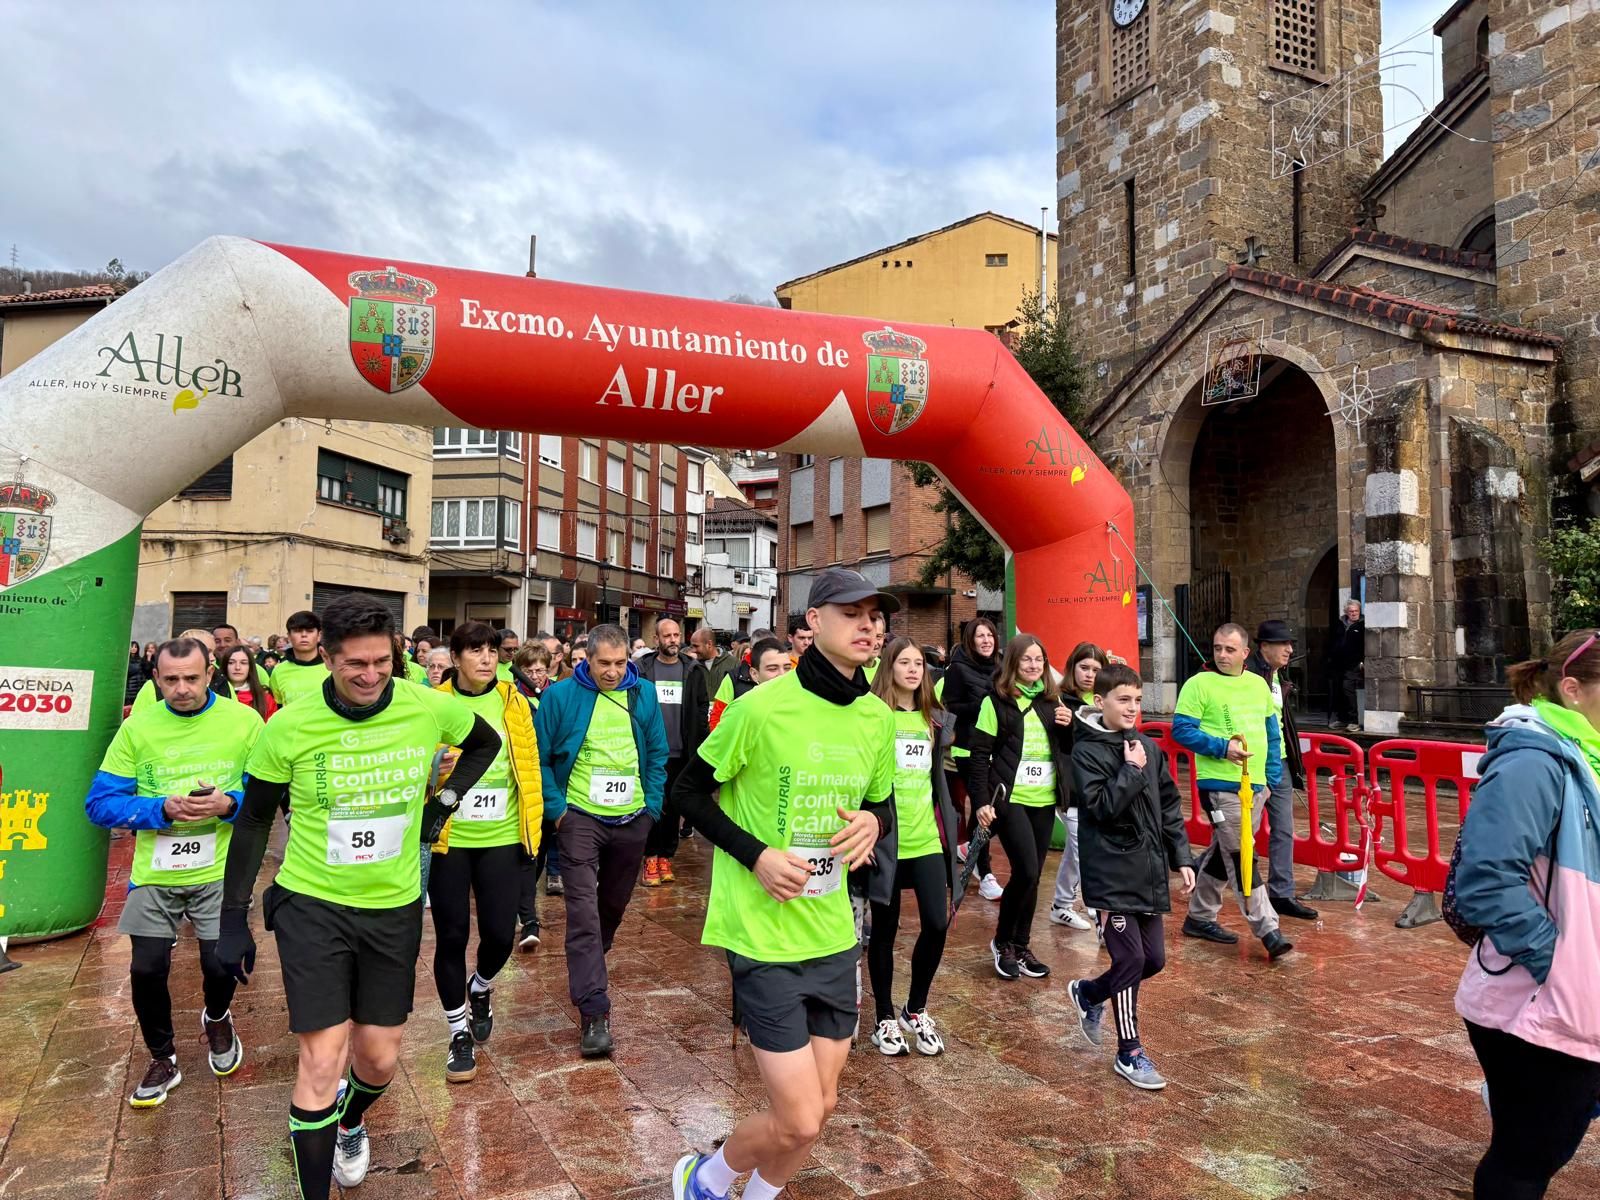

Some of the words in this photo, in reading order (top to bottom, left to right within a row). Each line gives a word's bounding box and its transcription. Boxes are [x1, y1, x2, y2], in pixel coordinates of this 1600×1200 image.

[460, 298, 574, 340] Excmo.
[583, 313, 808, 364] Ayuntamiento
[816, 341, 849, 368] de
[28, 379, 68, 390] ALLER,
[73, 380, 97, 391] HOY
[99, 381, 109, 392] Y
[112, 384, 168, 401] SIEMPRE
[596, 363, 724, 414] Aller
[1010, 468, 1026, 476] HOY
[1035, 469, 1069, 477] SIEMPRE
[51, 596, 67, 606] de
[0, 679, 74, 692] AGENDA
[662, 688, 674, 696] 114
[0, 693, 73, 713] 2030
[332, 754, 355, 769] En
[361, 745, 426, 765] marcha
[905, 744, 925, 757] 247
[157, 765, 176, 777] En
[180, 759, 235, 774] marcha
[332, 768, 405, 788] contra
[408, 761, 425, 779] el
[1026, 766, 1042, 777] 163
[217, 771, 231, 784] el
[314, 752, 329, 810] ASTURIAS
[796, 770, 818, 786] En
[605, 781, 627, 793] 210
[473, 794, 496, 808] 211
[777, 765, 791, 837] ASTURIAS
[793, 790, 849, 809] contra
[851, 794, 861, 808] e
[171, 841, 201, 856] 249
[351, 830, 376, 849] 58
[807, 857, 835, 876] 235
